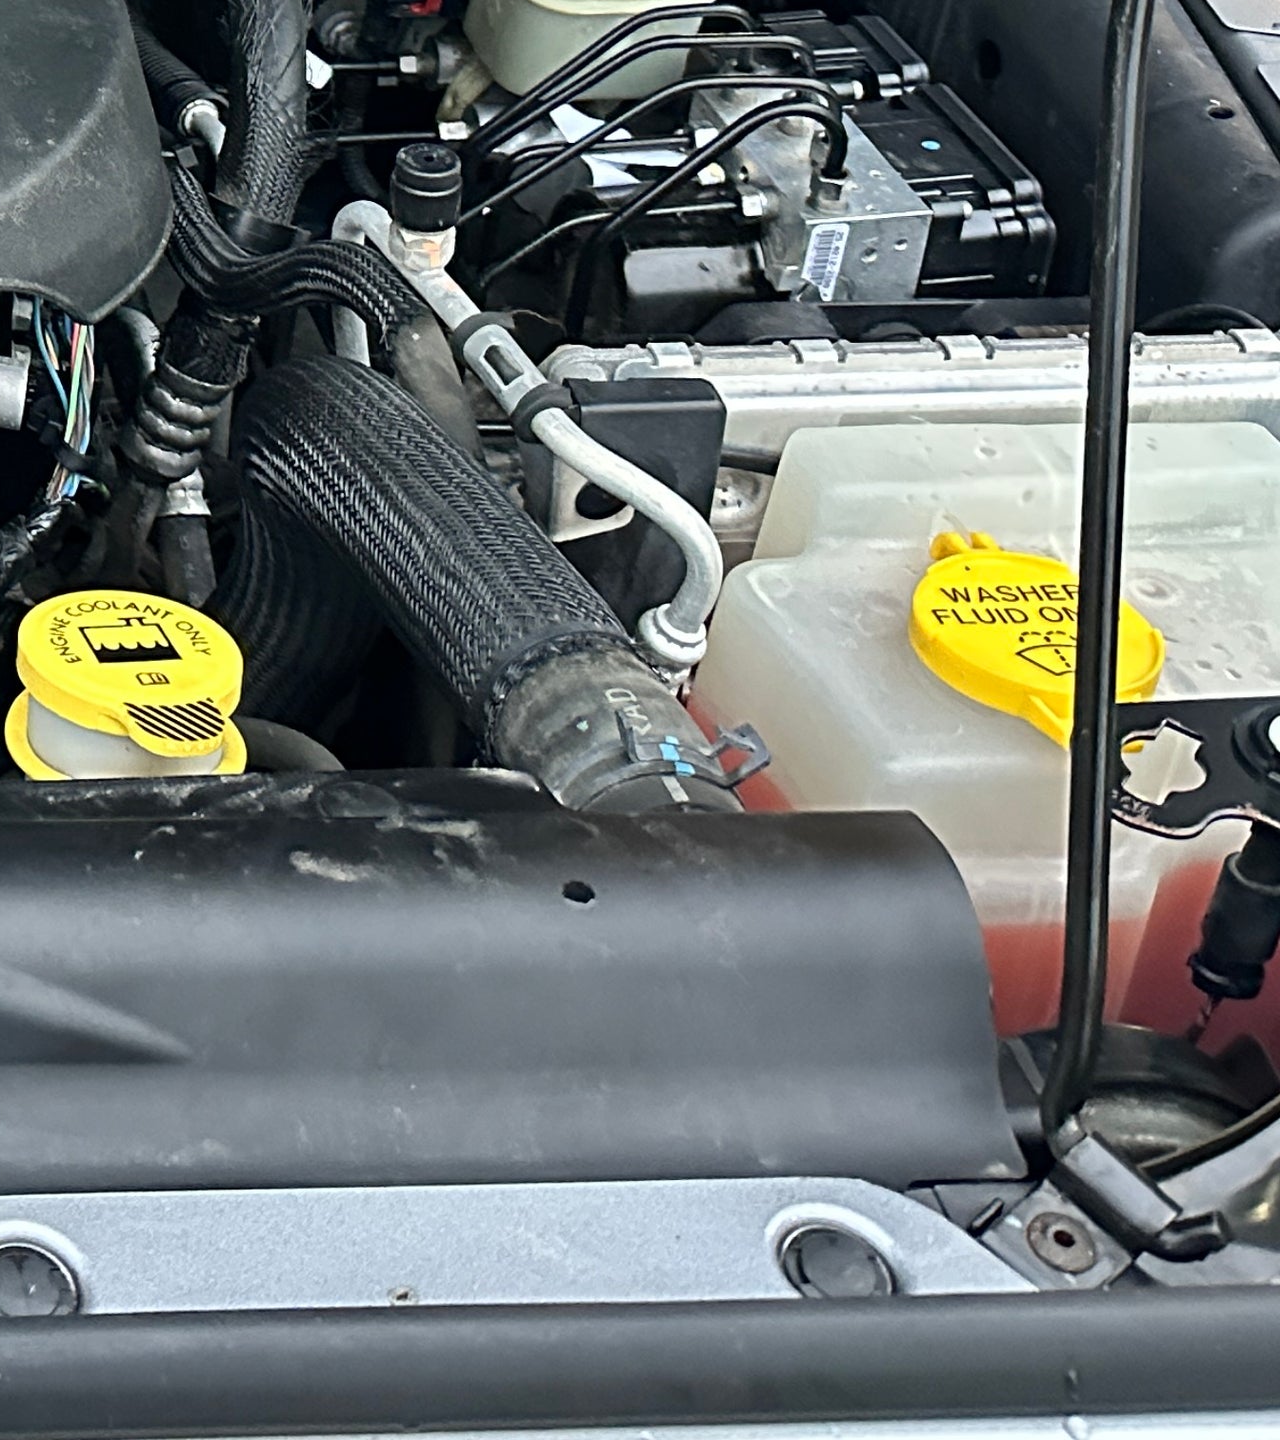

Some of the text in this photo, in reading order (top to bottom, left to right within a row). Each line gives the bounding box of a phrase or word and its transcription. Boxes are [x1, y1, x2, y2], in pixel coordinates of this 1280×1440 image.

[940, 583, 1080, 604] WASHER
[931, 606, 1029, 626] FLUID
[50, 599, 212, 665] ENGINE COOLANT ONLY
